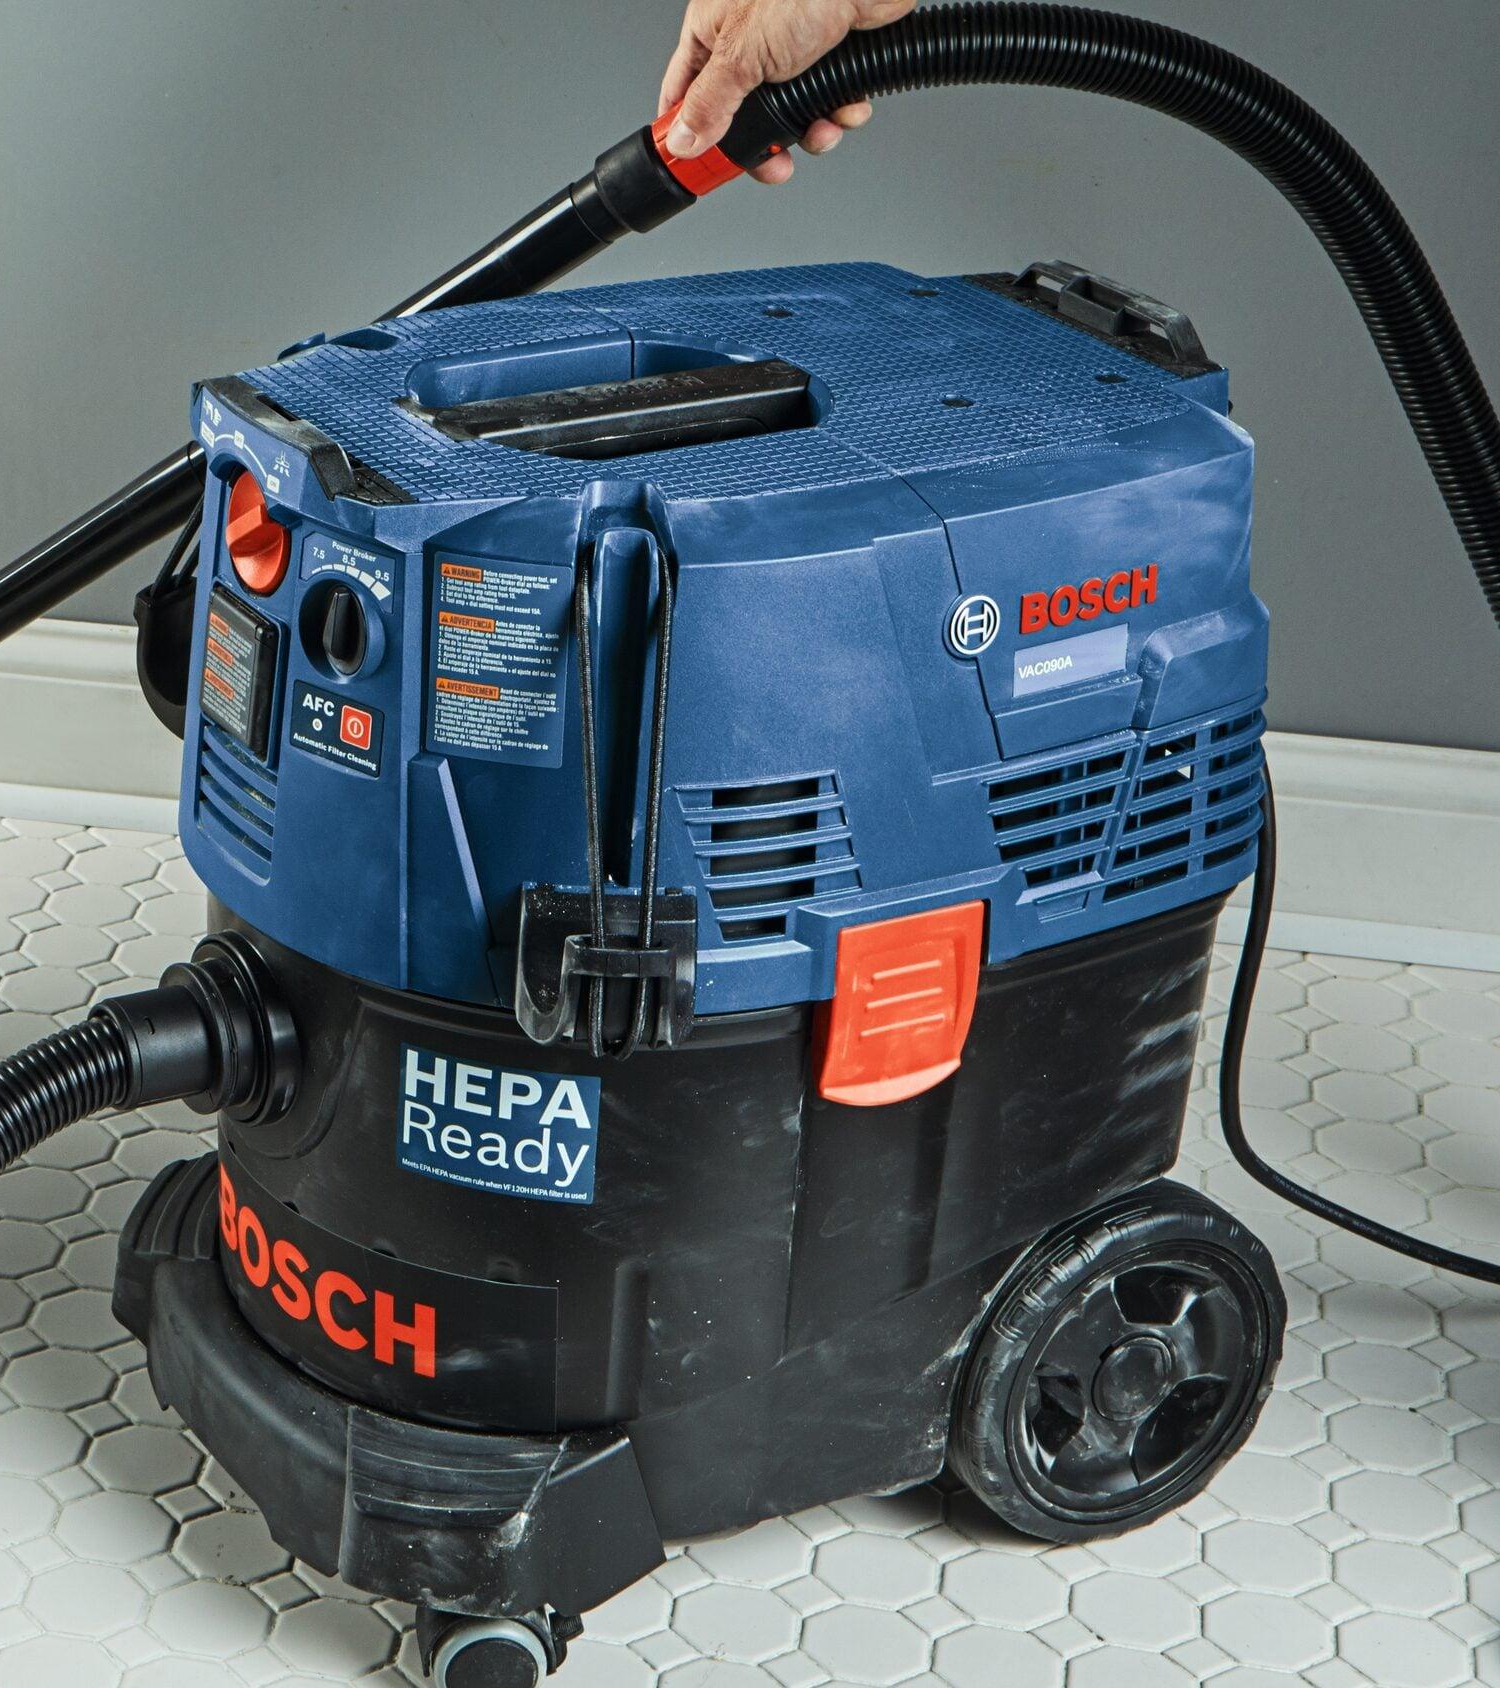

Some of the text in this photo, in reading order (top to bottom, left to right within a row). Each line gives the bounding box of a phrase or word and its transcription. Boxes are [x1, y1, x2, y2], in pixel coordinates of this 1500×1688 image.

[312, 547, 325, 559] 7.5
[332, 541, 376, 561] Power Broker
[342, 554, 356, 566] 8.5
[375, 570, 389, 582] 9.5
[451, 566, 480, 579] WARNING
[1019, 563, 1159, 635] BOSCH
[450, 615, 492, 629] ADVERTENCIA
[1018, 655, 1073, 680] VAC090A
[447, 682, 497, 697] AVERTISSEMENT
[302, 693, 335, 717] AFC
[293, 732, 377, 771] Automatic Filter Cleaning
[405, 1049, 591, 1129] HEPA
[402, 1100, 590, 1187] Ready
[402, 1158, 419, 1169] Meets
[420, 1164, 431, 1173] EPA
[432, 1167, 448, 1177] HEPA
[449, 1173, 472, 1184] vacuum
[486, 1181, 502, 1189] when
[530, 1188, 548, 1196] HEPA
[549, 1189, 564, 1198] filter
[218, 1161, 436, 1378] BOSCH
